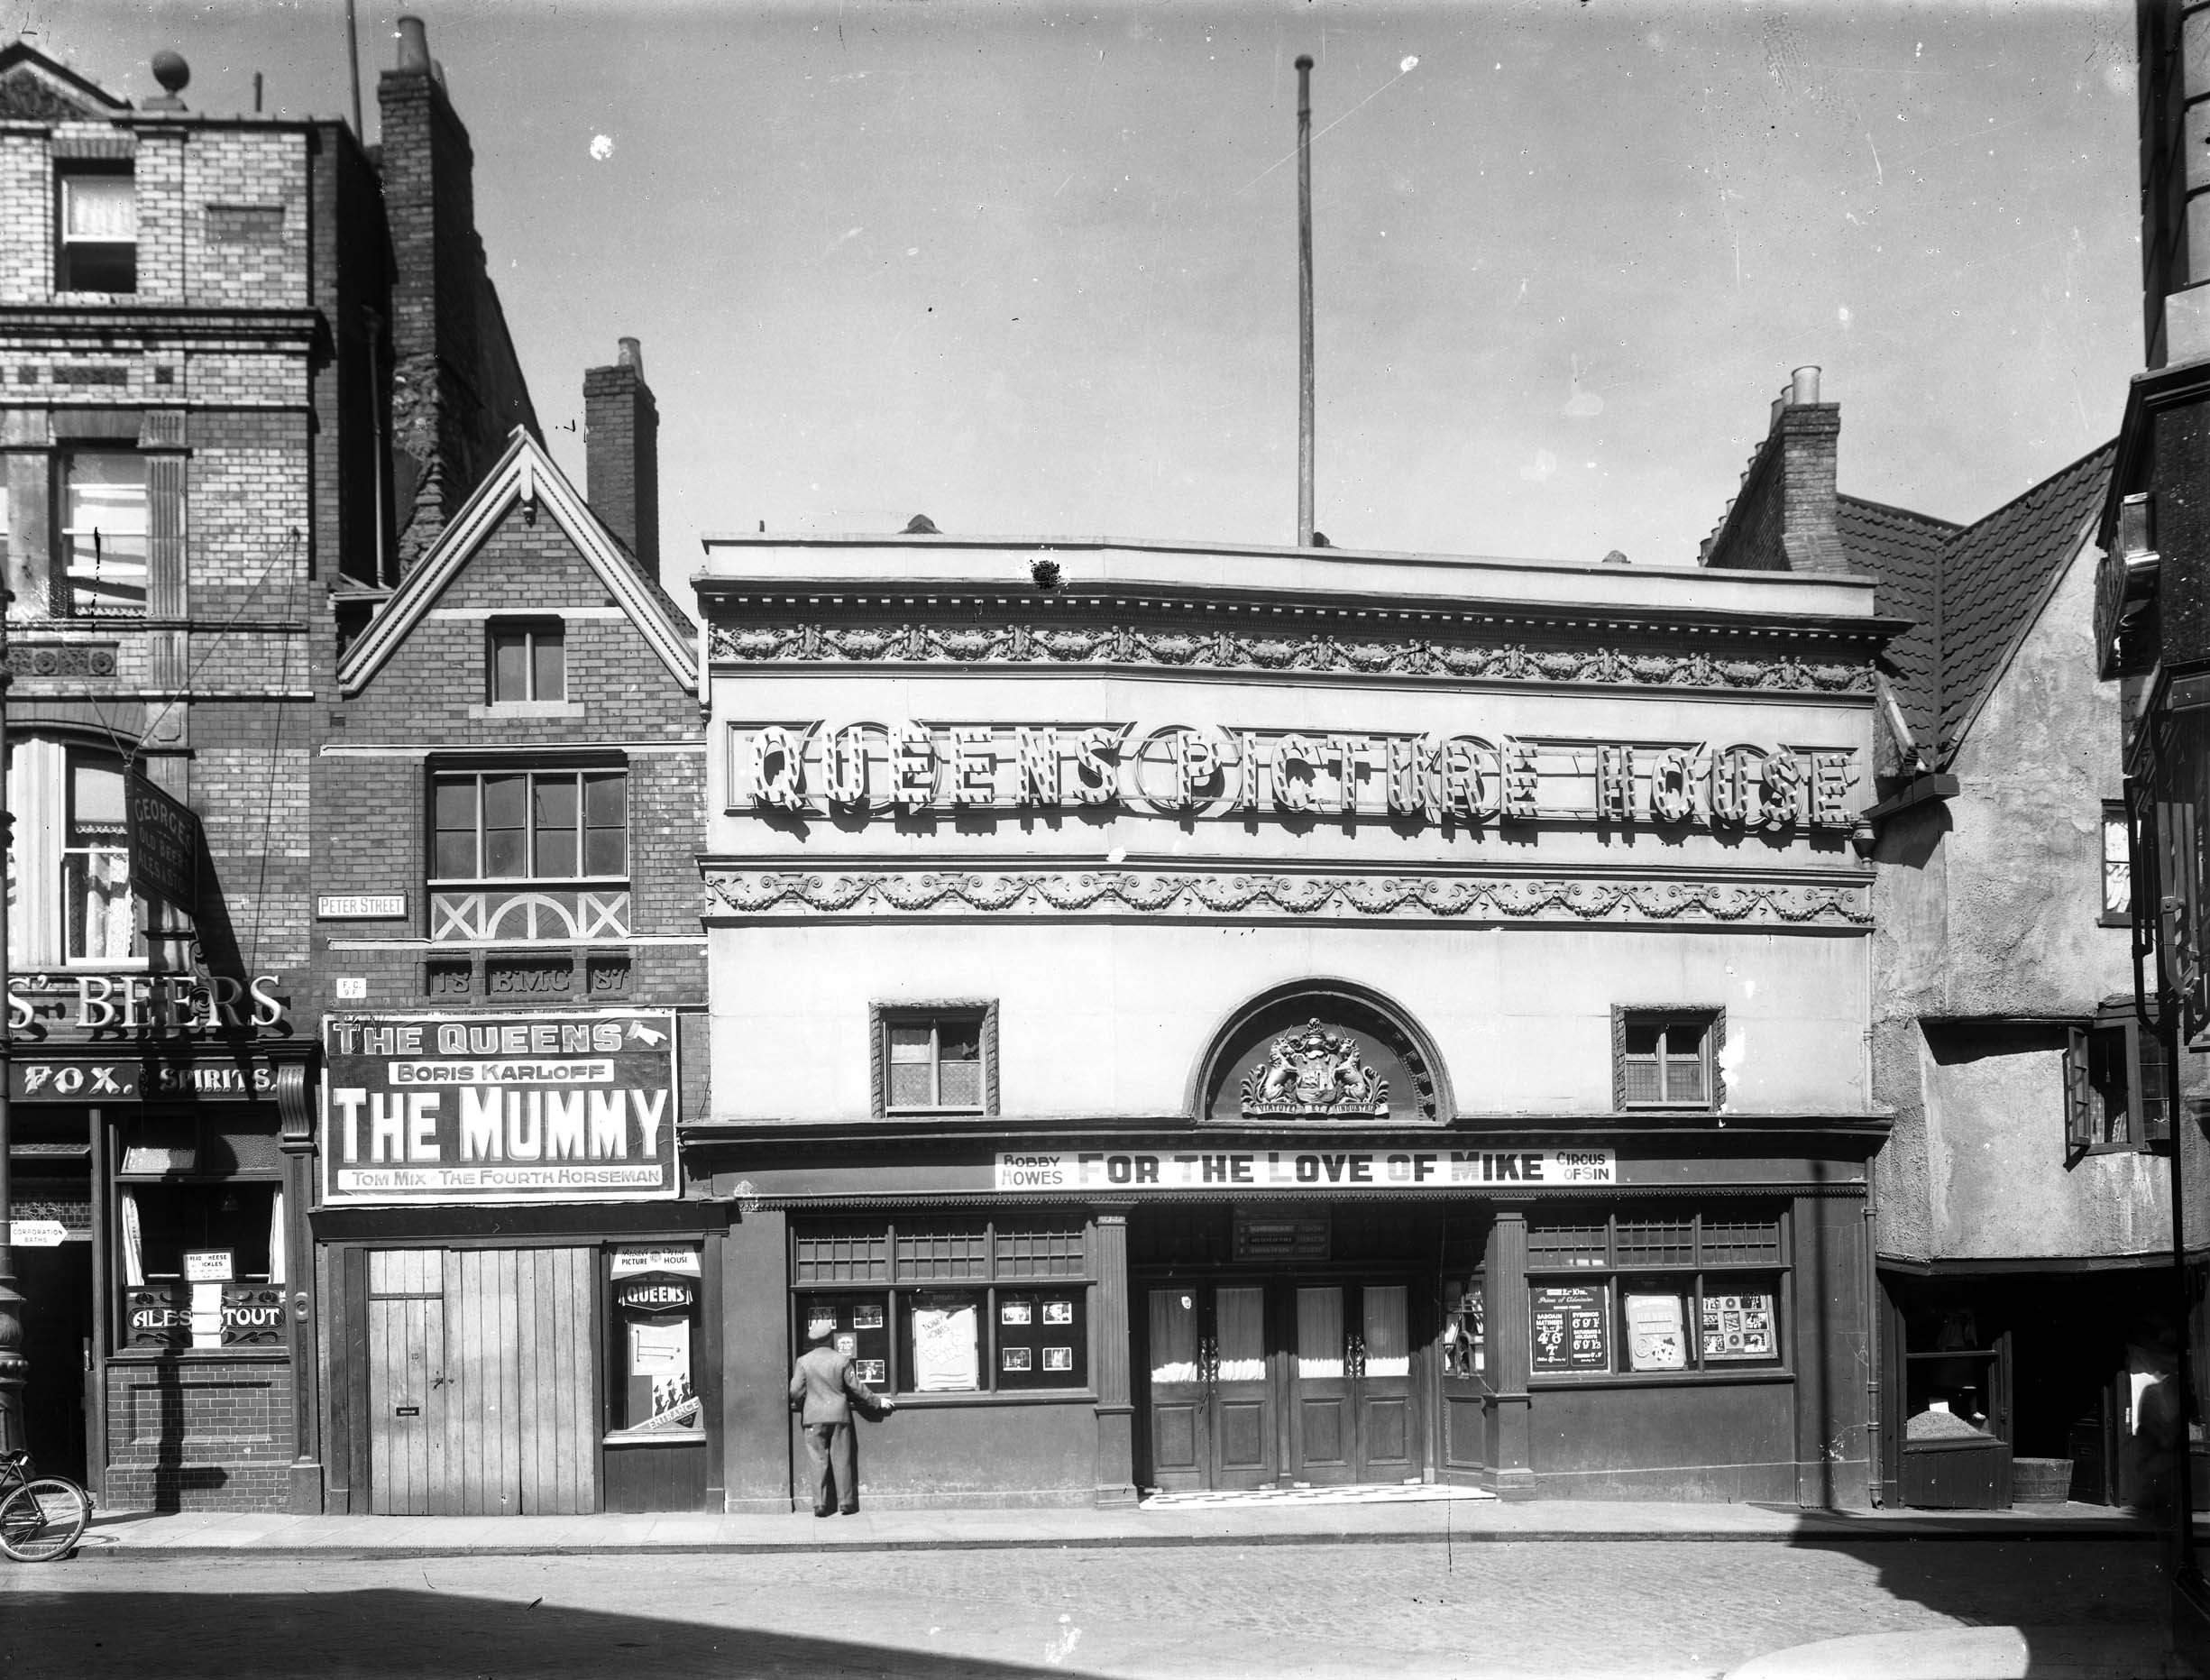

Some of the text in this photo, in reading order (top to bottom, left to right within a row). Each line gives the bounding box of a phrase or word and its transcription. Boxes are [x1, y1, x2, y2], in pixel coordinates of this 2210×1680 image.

[750, 725, 1852, 824] QUEENS PICTURE HOUSE
[139, 827, 156, 851] OLD
[321, 896, 402, 914] PETER STREET
[76, 975, 281, 1028] BEERS
[334, 1023, 622, 1054] THE QUEENS
[24, 1066, 133, 1094] FOX.
[398, 1064, 605, 1081] BORIS KARLOFF
[333, 1087, 668, 1163] THE MUMMY
[1004, 1154, 1061, 1168] BOBBY
[1078, 1151, 1544, 1183] FOR THE LOVE OF MIKE
[1556, 1152, 1606, 1165] CIRCUS
[352, 1167, 660, 1187] TOM MIX THE FOURTH HORSEMAN
[1002, 1171, 1063, 1186] HOWES
[1564, 1167, 1609, 1180] OF SIN
[14, 1228, 63, 1236] CORPORATION
[621, 1258, 647, 1266] PICTURE
[664, 1256, 687, 1265] HOUSE
[627, 1286, 685, 1304] QUEENS
[133, 1308, 280, 1328] ALES TOUT
[649, 1400, 700, 1429] ENTRANCE
